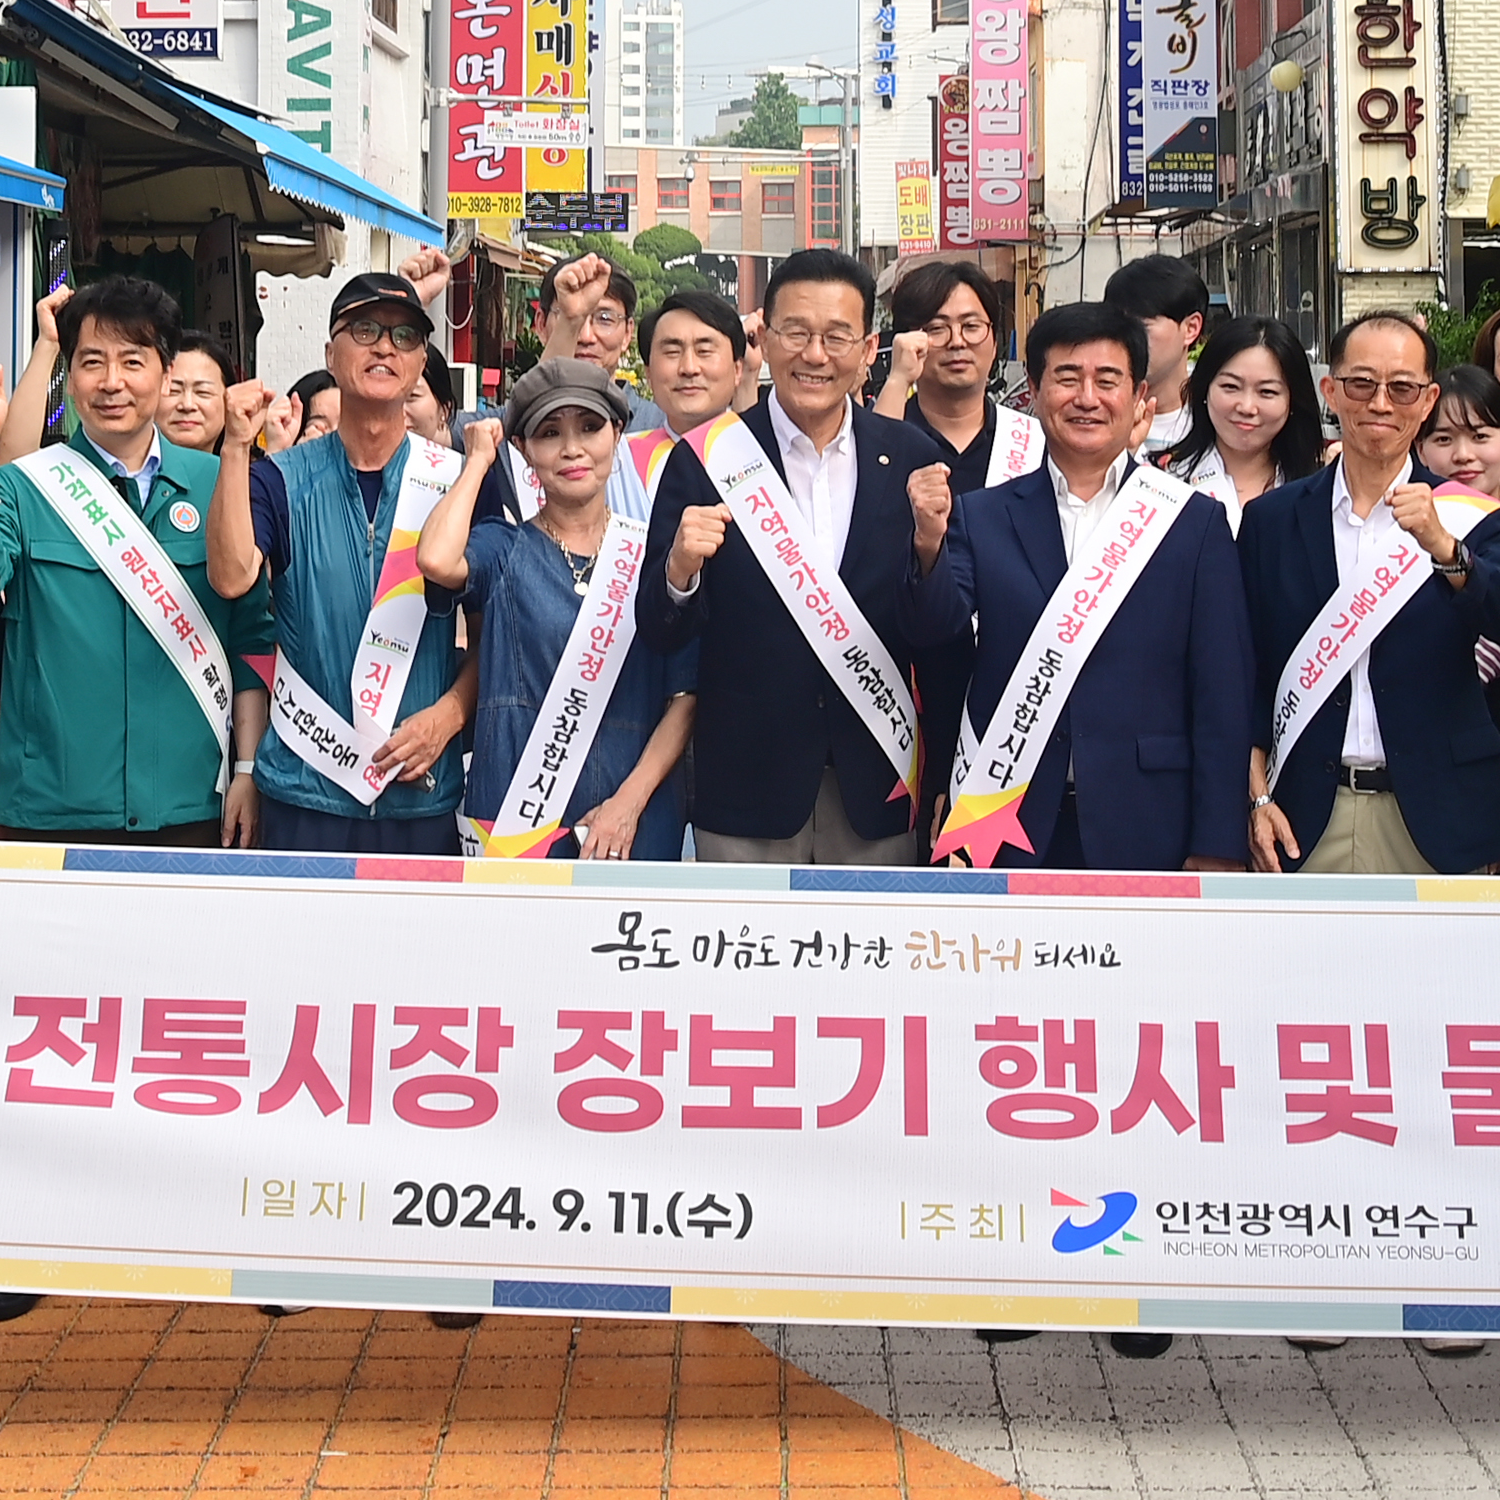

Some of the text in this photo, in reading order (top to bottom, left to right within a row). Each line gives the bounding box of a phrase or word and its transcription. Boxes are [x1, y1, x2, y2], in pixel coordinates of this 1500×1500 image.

[124, 29, 215, 54] 32-6841
[974, 6, 1026, 207] 왕짬뽕
[1150, 79, 1211, 97] 직판장
[899, 185, 928, 206] 도배
[900, 213, 931, 236] 장판
[973, 217, 1026, 231] 831-2111
[720, 461, 767, 492] Yeonsu
[1136, 478, 1180, 506] Yeonsu
[47, 460, 128, 548] 가격표시
[120, 548, 209, 664] 원산지표시
[744, 485, 852, 643] 지역물가안정
[1298, 544, 1421, 692] 지역물가안정
[366, 629, 412, 657] Yeonsu
[986, 498, 1159, 790] 지역물가안정 동참합시다
[517, 538, 644, 828] 지역물가안정 동참합시다
[590, 910, 1122, 974] 몸도 마음도 건강한 한가위 되세요
[1, 991, 517, 1129] 전통시장
[550, 1007, 930, 1136] 장보기
[971, 1013, 1239, 1147] 행사
[1274, 1020, 1398, 1149] 및
[391, 1181, 537, 1232] 2024.
[551, 1188, 591, 1234] 9.
[1155, 1201, 1353, 1239] 인천광역시
[1363, 1203, 1480, 1241] 연수구
[1162, 1241, 1482, 1262] INCHEON METROPOLITAN YEONSU-GU
